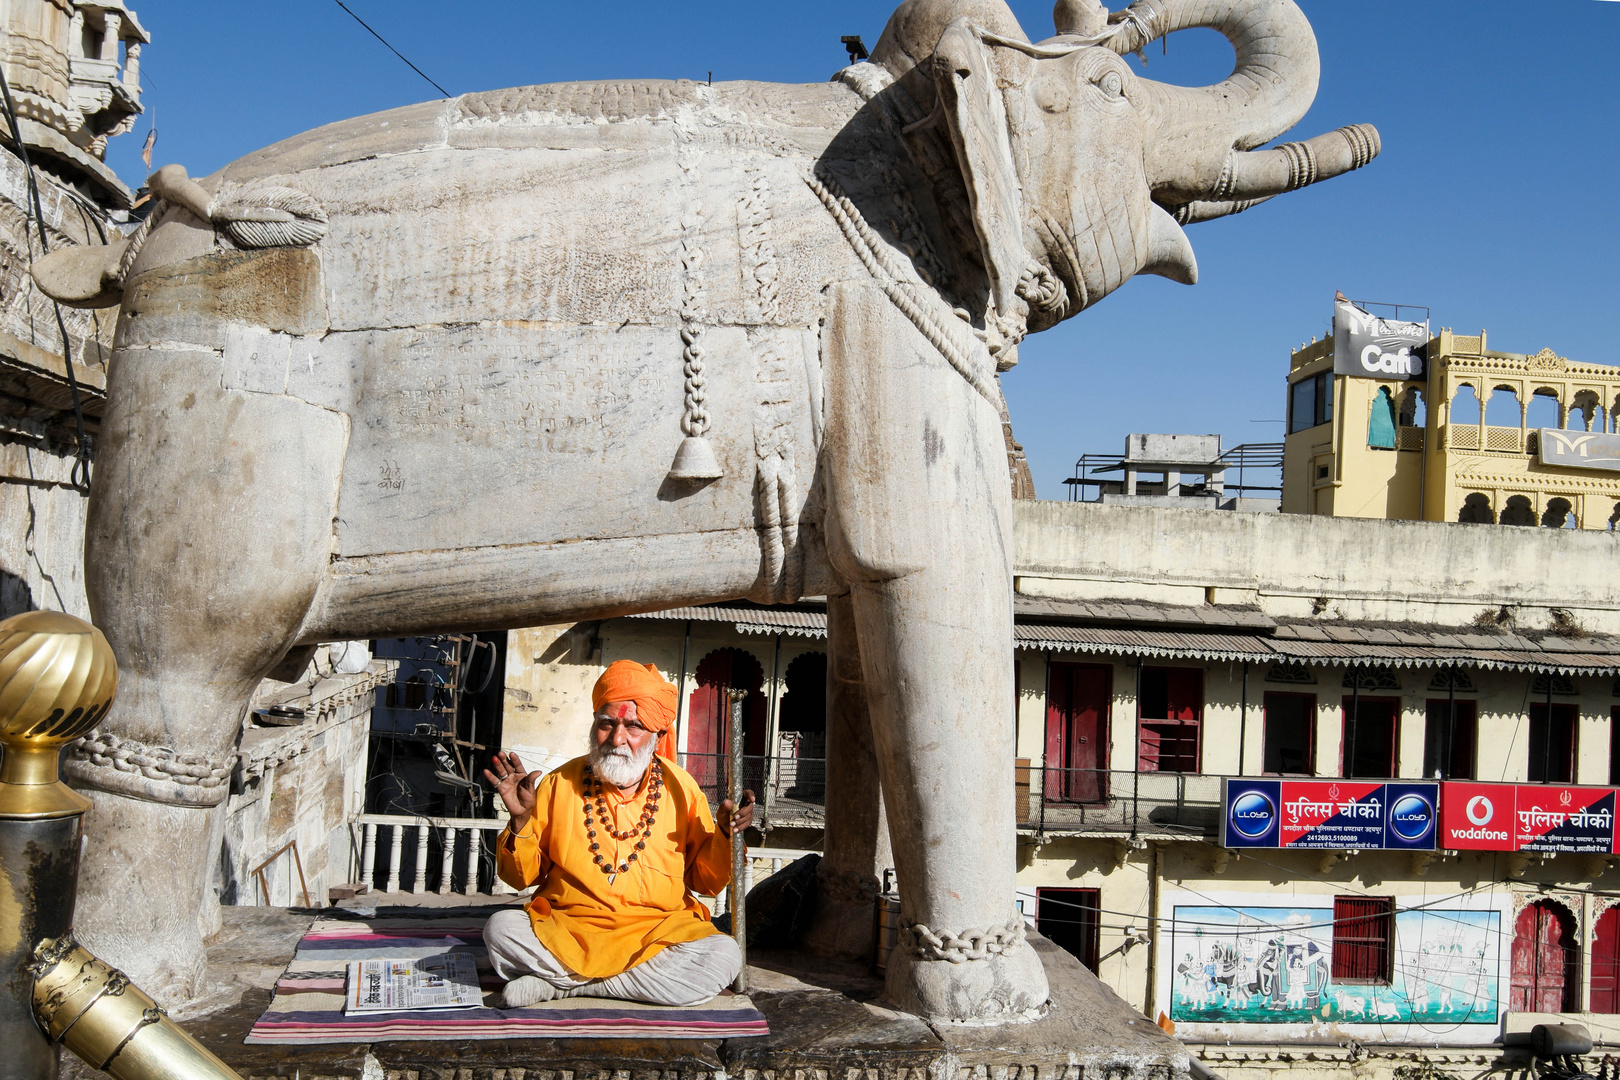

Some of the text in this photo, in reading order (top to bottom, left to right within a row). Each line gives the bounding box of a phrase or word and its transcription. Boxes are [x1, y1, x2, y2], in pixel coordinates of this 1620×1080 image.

[1361, 344, 1423, 376] Cafe
[1237, 811, 1269, 819] LLOYD
[1284, 796, 1382, 823] पुलिस चौकी
[1517, 805, 1612, 833] पुलिस चौकी
[1450, 827, 1508, 840] vodafone
